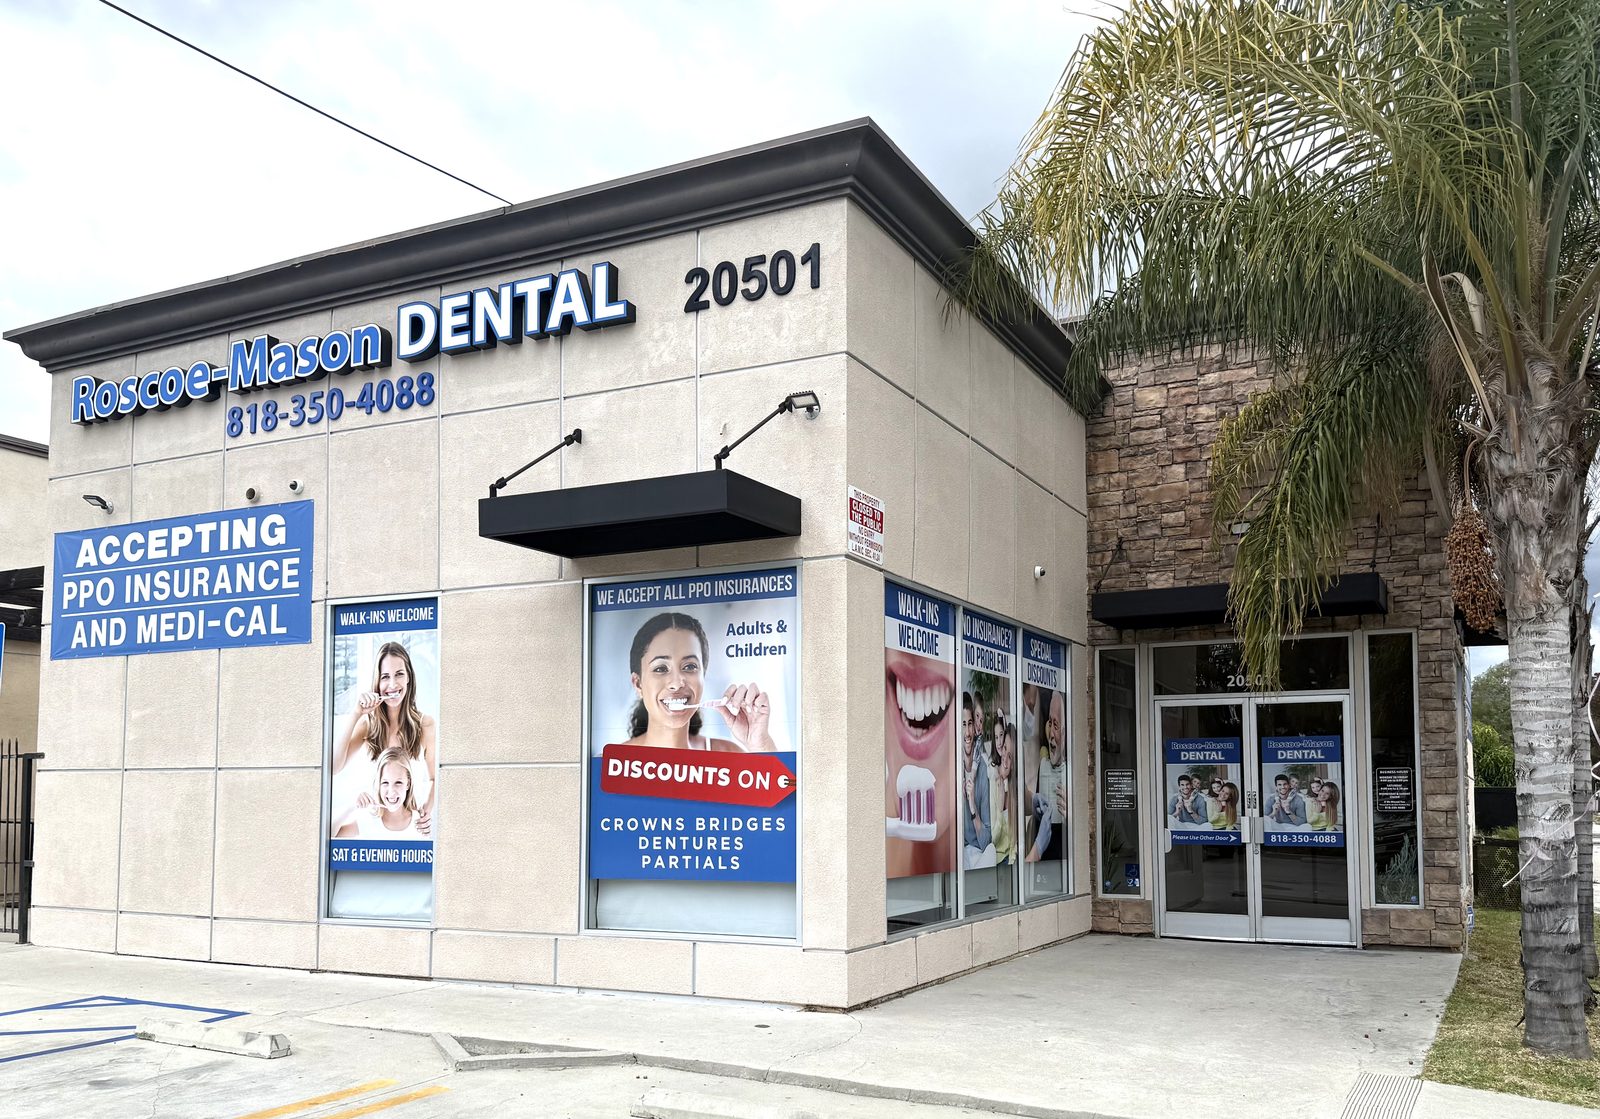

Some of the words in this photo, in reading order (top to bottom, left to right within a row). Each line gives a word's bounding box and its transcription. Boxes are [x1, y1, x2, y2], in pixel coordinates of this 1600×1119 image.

[684, 242, 820, 313] 20501
[71, 322, 386, 424] Roscoe-Mason
[397, 261, 630, 361] DENTAL
[227, 372, 436, 437] 818-350-4088
[851, 510, 862, 524] THE
[862, 514, 882, 532] PUBLIC
[852, 500, 873, 517] CLOSED
[873, 509, 881, 521] TO
[75, 513, 287, 568] ACCEPTING
[61, 576, 116, 610] PPO
[124, 558, 300, 605] INSURANCE
[597, 589, 614, 605] WE
[617, 585, 661, 604] ACCEPT
[663, 584, 686, 600] ALL
[688, 582, 711, 598] PPO
[714, 574, 793, 597] INSURANCES
[340, 610, 386, 626] WALK-INS
[387, 607, 434, 623] WELCOME
[897, 590, 940, 627] WALK-INS
[70, 617, 126, 649] AND
[135, 605, 287, 645] MEDI-CAL
[726, 620, 773, 637] Adults
[776, 619, 788, 633] &
[962, 613, 971, 638] NO
[972, 616, 1013, 649] INSURANCE?
[725, 643, 787, 658] Children
[898, 623, 940, 656] WELCOME
[1029, 637, 1053, 663] SPECIAL
[965, 644, 975, 665] NO
[976, 646, 1009, 675] PROBLEM!
[1027, 662, 1058, 687] DISCOUNTS
[1226, 674, 1272, 687] 200
[1171, 741, 1235, 750] Roscoe-Mason
[1267, 739, 1334, 749] Roscoe-Mason
[1277, 750, 1325, 759] DENTAL
[1180, 751, 1225, 761] DENTAL
[608, 759, 730, 786] DISCOUNTS
[738, 770, 771, 790] ON
[600, 817, 685, 831] CROWNS
[695, 817, 786, 831] BRIDGES
[638, 836, 744, 850] DENTURES
[1270, 834, 1337, 843] 818-350-4088
[332, 848, 350, 862] SAT
[351, 848, 358, 862] &
[359, 848, 399, 863] EVENING
[401, 849, 433, 863] HOURS
[641, 855, 740, 869] PARTIALS
